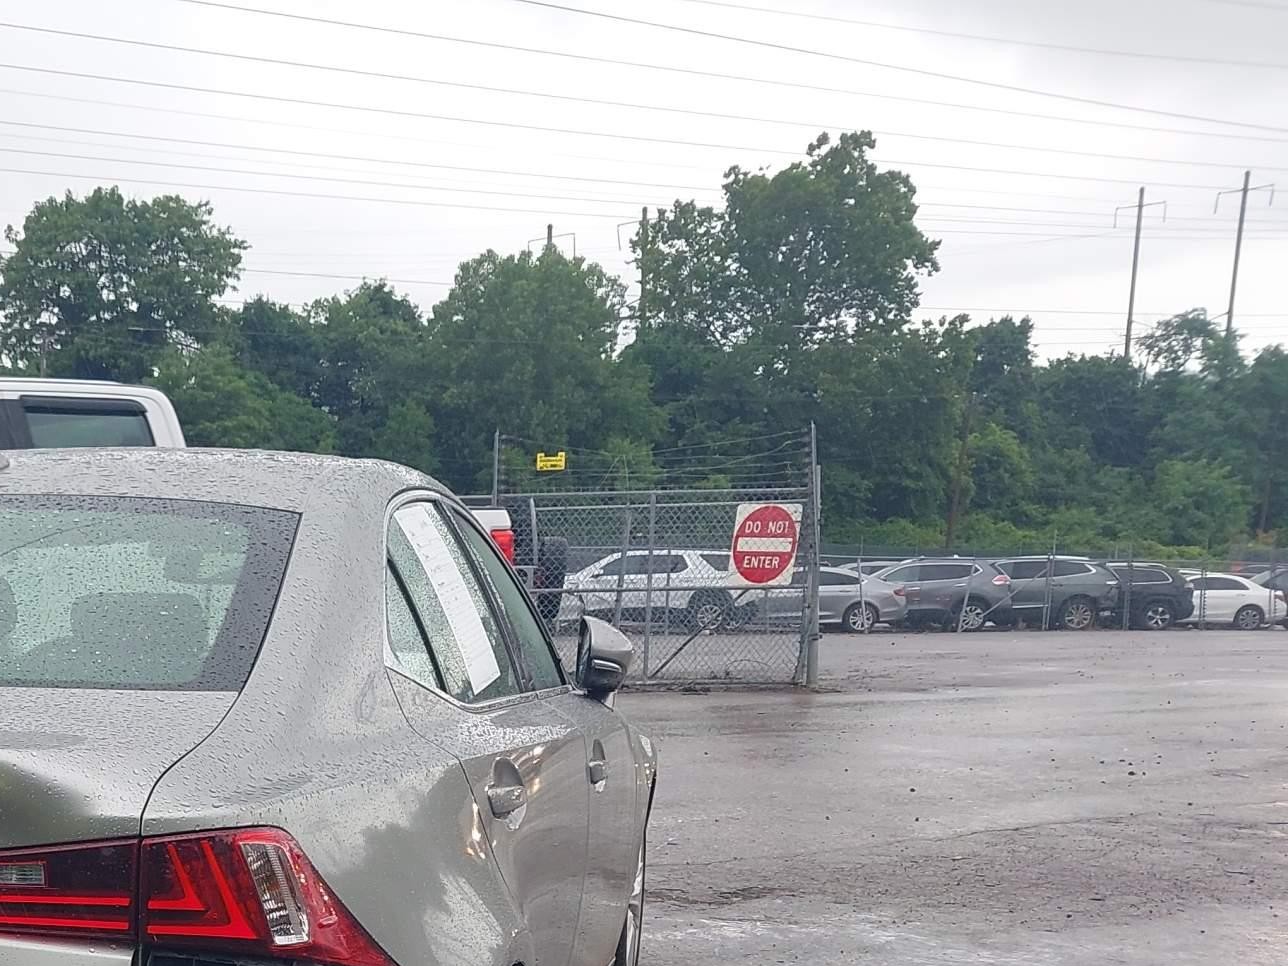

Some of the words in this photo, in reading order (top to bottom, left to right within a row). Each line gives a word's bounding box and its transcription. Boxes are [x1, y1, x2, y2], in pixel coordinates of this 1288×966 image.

[745, 521, 761, 533] DO
[767, 521, 789, 534] NOT
[743, 556, 780, 569] ENTER
